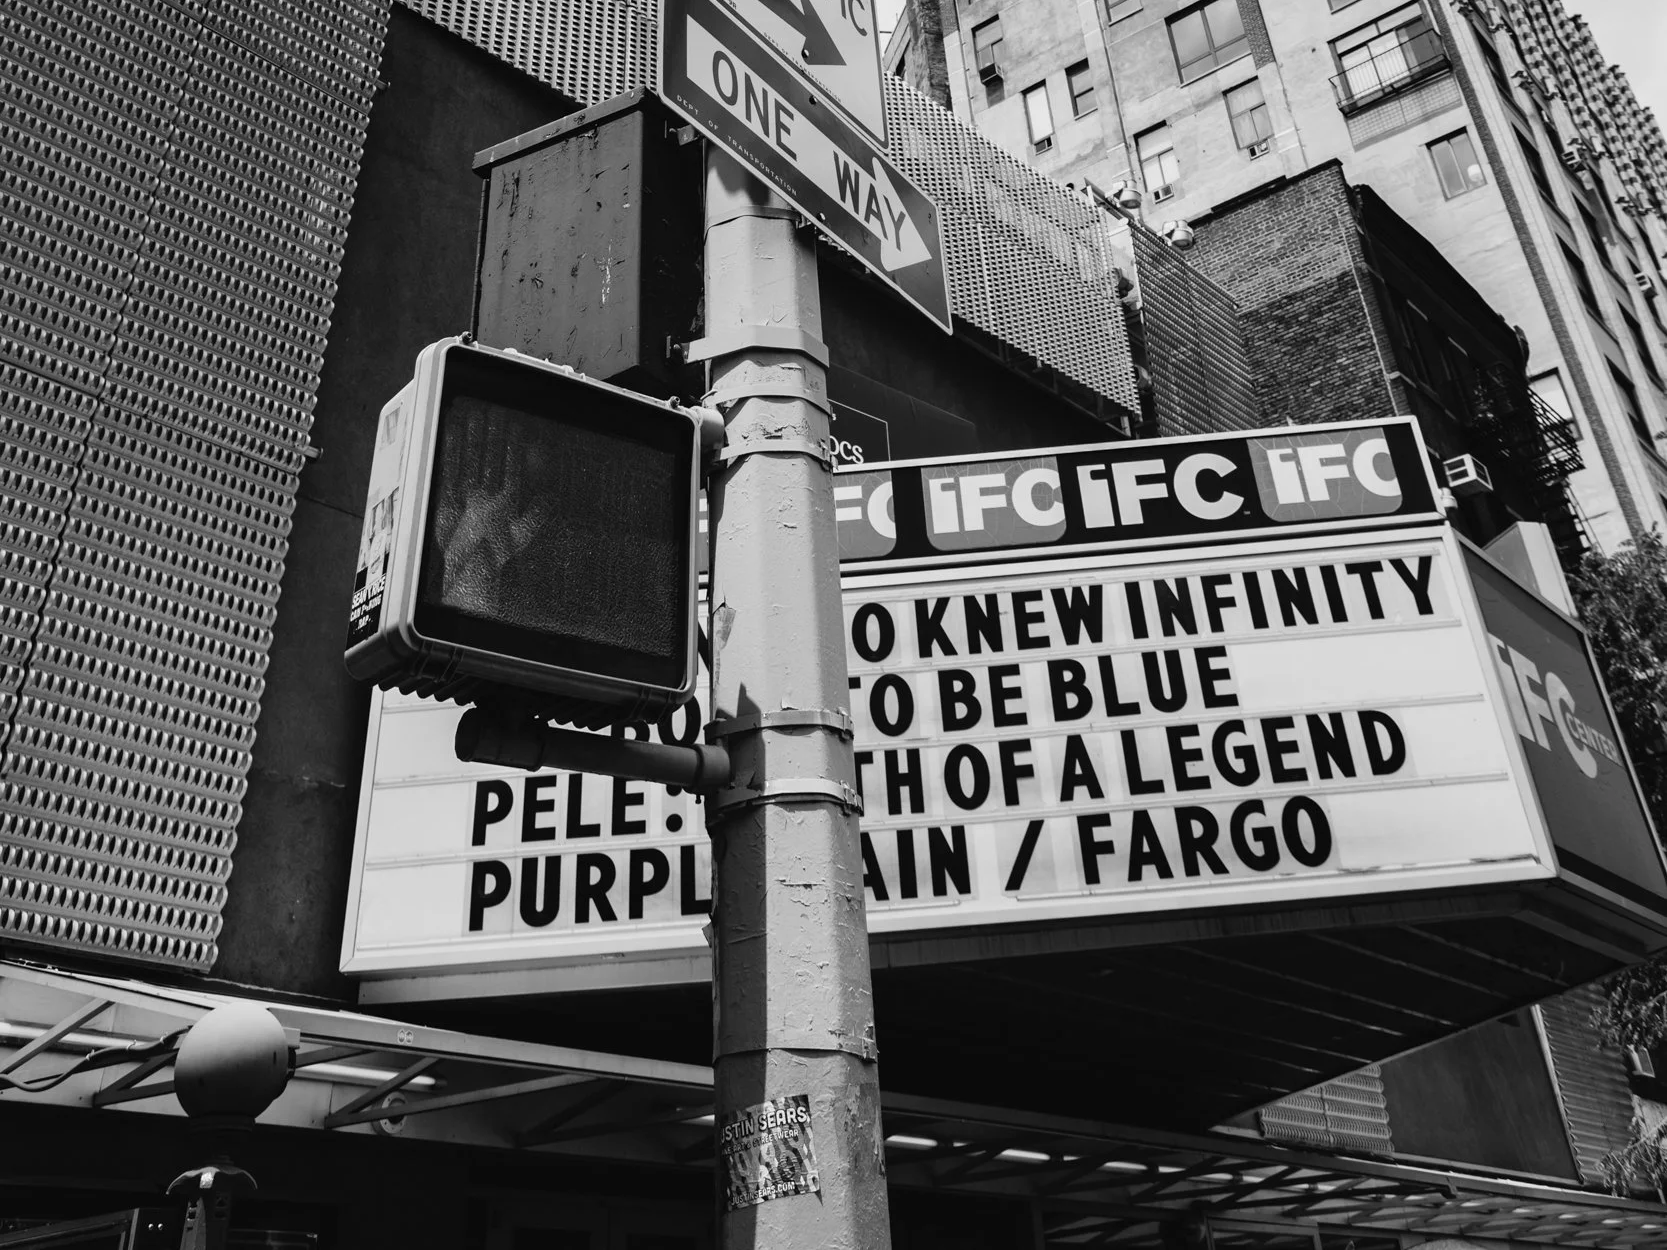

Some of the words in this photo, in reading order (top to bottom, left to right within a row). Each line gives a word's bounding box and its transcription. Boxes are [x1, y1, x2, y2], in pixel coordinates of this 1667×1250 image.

[676, 94, 699, 115] DEPT
[708, 119, 719, 130] OF
[727, 135, 798, 196] TRANSPORTATION
[712, 50, 798, 162] ONE
[833, 150, 906, 252] WAY
[914, 583, 1104, 659] KNEW
[1124, 555, 1435, 639] INFINITY
[937, 663, 1029, 733] BE
[1046, 645, 1240, 722] BLUE
[1565, 711, 1624, 768] CENTER
[943, 738, 1036, 811] OF
[1060, 724, 1105, 803] A
[1120, 709, 1407, 797] LEGEND
[468, 844, 713, 933] PURPL
[860, 825, 972, 901] AIN
[1004, 819, 1045, 892] /
[1076, 795, 1333, 886] FARGO
[758, 1106, 808, 1131] SEARS
[731, 1181, 796, 1206] JUSTINSEARS.COM
